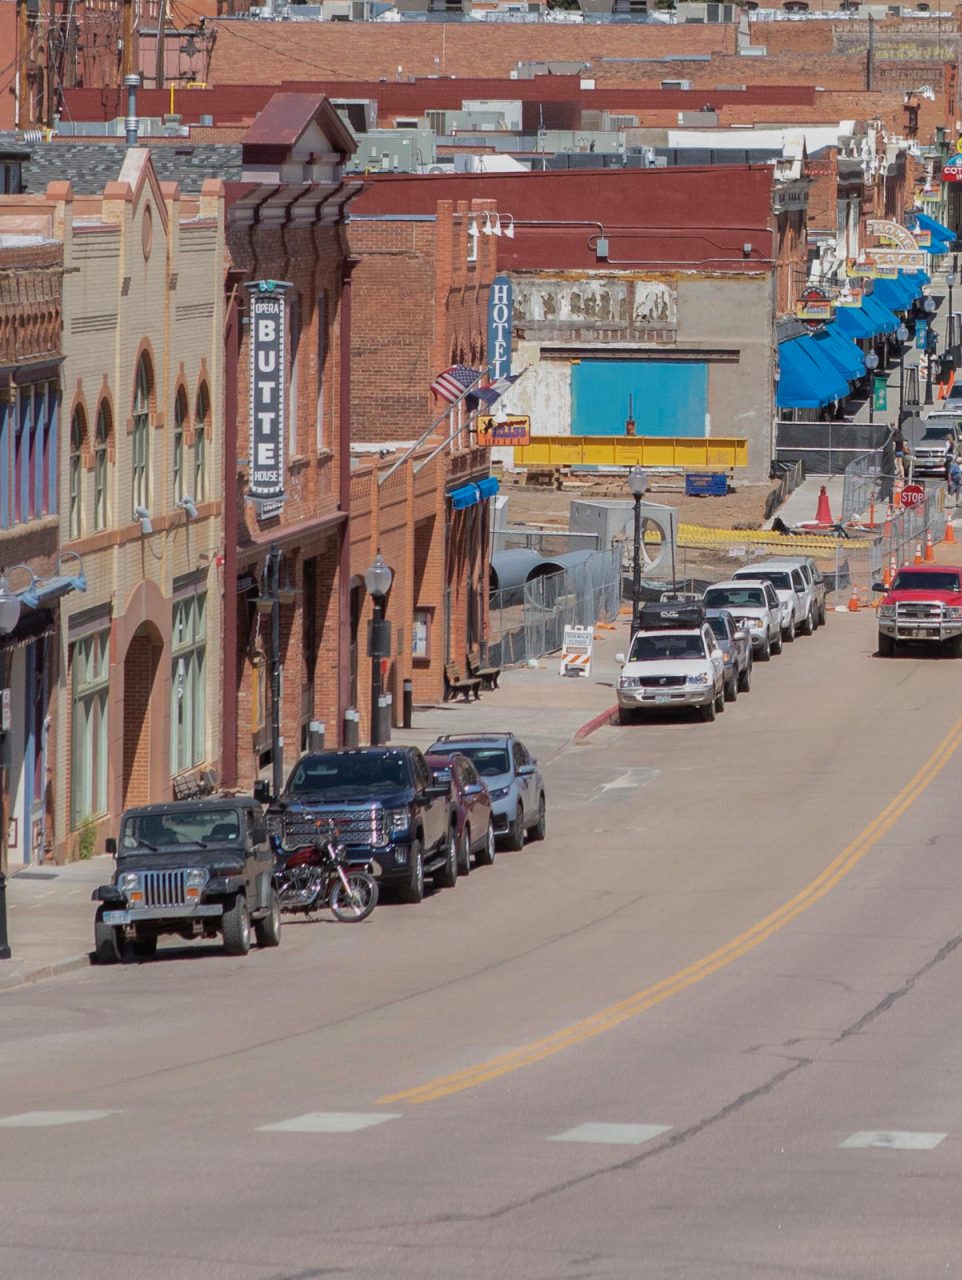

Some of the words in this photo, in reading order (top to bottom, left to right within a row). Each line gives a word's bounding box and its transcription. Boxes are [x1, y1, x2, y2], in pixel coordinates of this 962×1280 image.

[255, 303, 279, 314] OPERA
[493, 284, 509, 380] HOTEL
[257, 319, 276, 466] BUTTE
[254, 471, 278, 482] HOUSE
[902, 492, 924, 502] STOP
